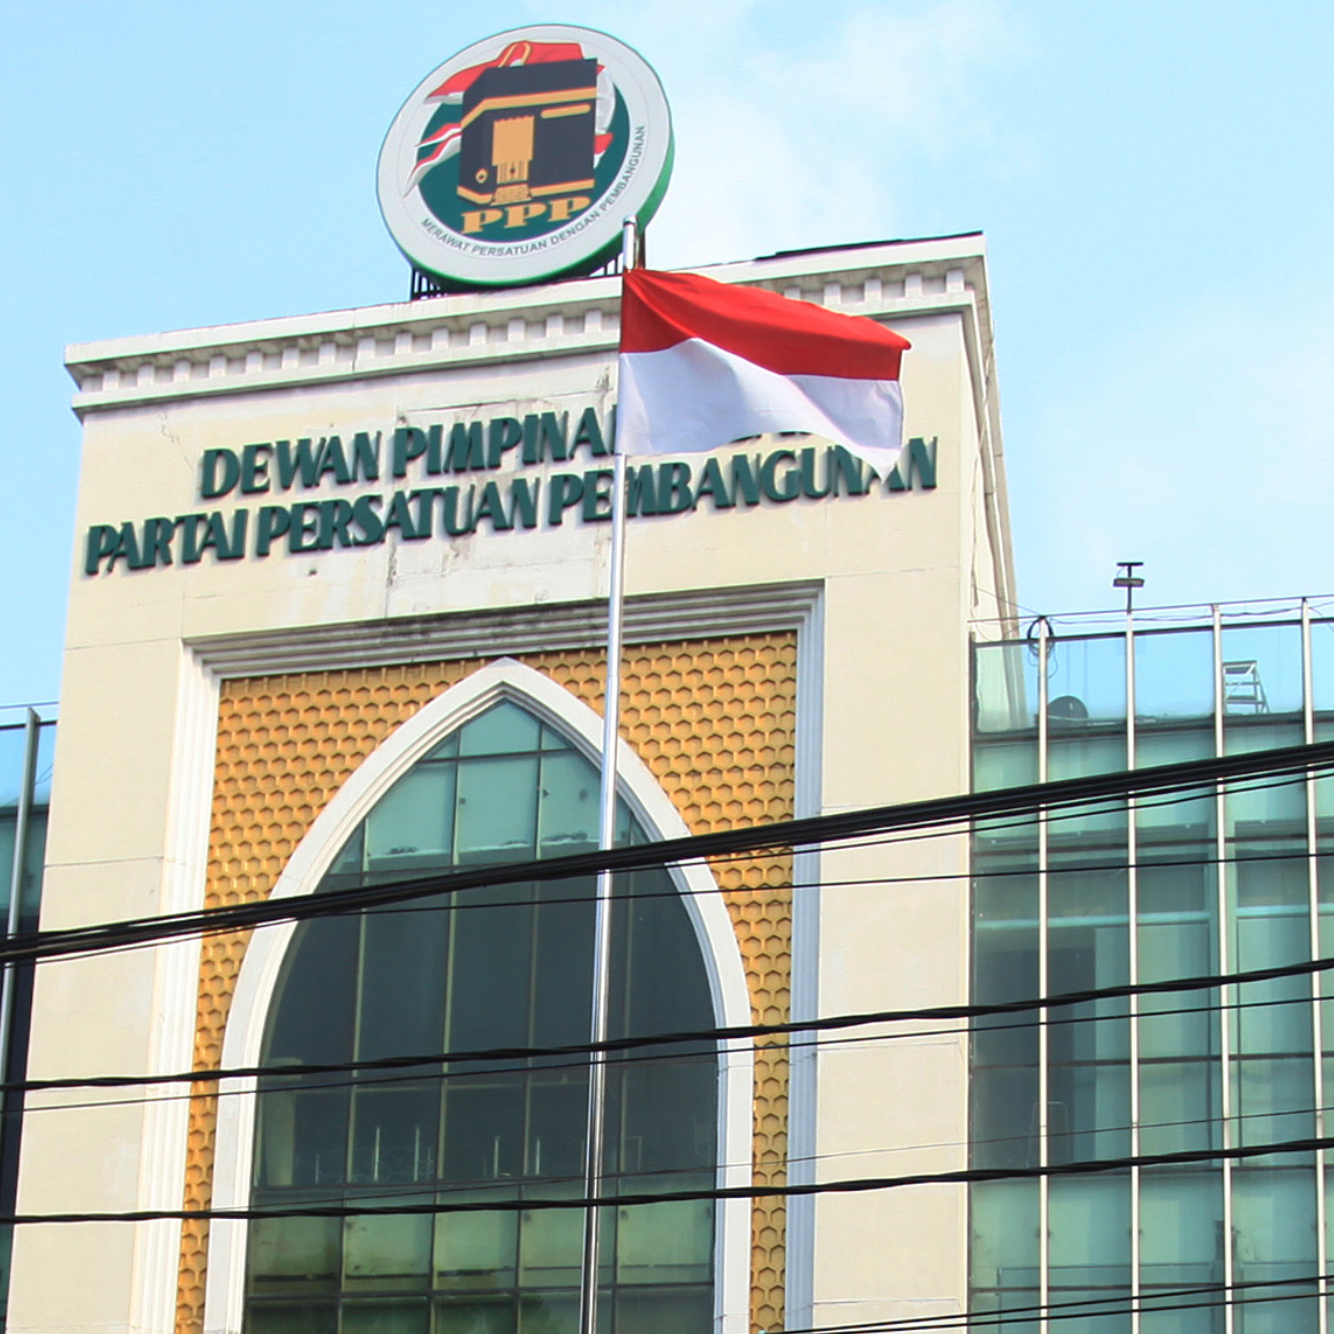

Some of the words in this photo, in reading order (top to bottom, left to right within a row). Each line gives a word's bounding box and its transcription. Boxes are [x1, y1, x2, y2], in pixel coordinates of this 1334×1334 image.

[420, 217, 471, 252] MERAWAT
[471, 240, 548, 257] PERSATUAN
[550, 211, 601, 247] DENGAN
[600, 125, 646, 212] PEMBANGUNAN
[461, 196, 592, 234] PPP
[200, 431, 382, 500] DEWAN
[393, 404, 617, 477] PIMPINA
[85, 508, 249, 576] PARTAI
[255, 476, 541, 557] PERSATUAN
